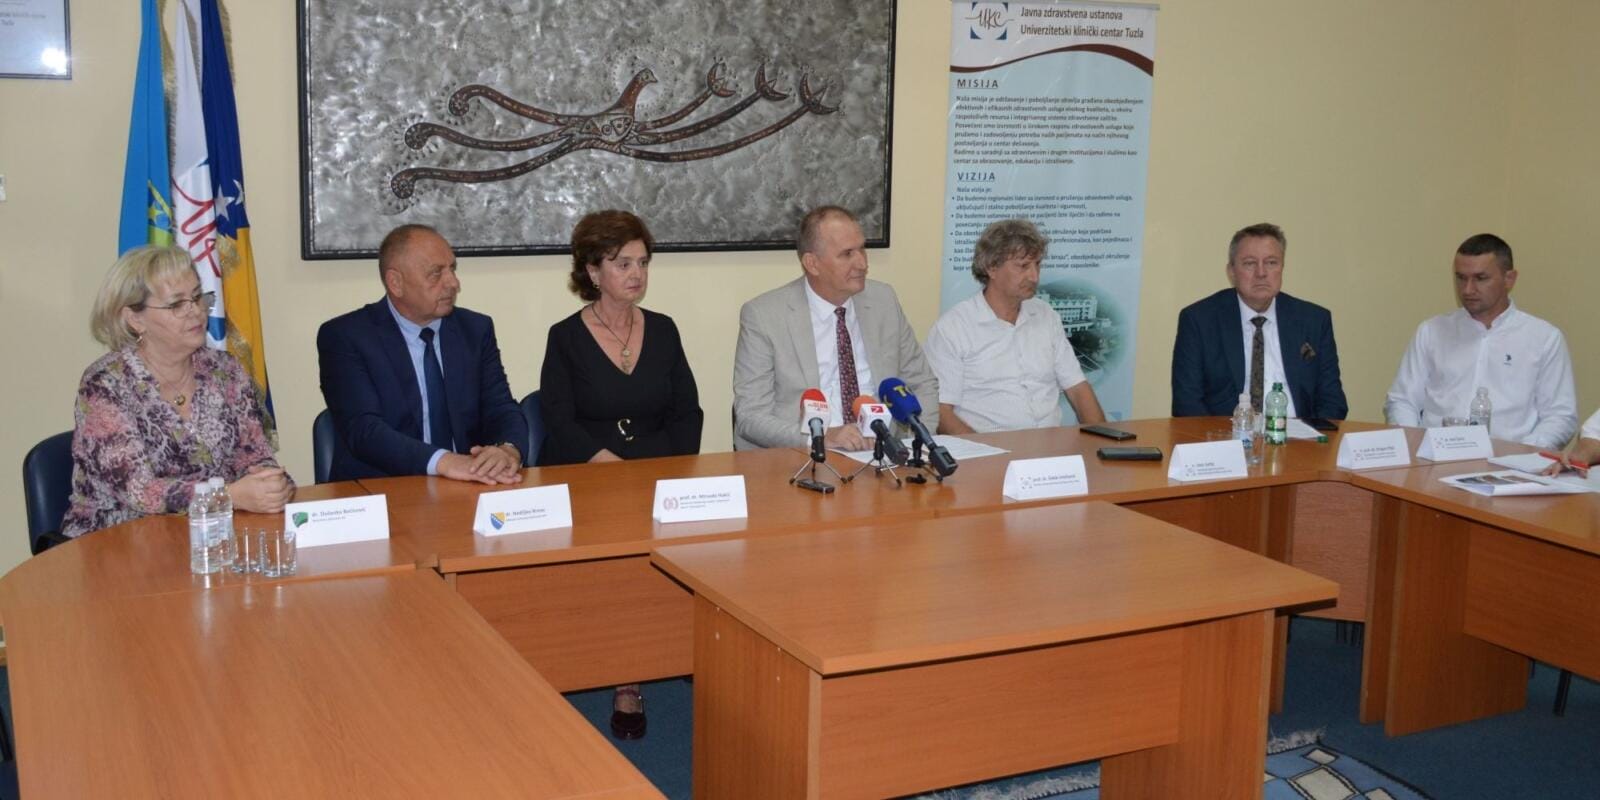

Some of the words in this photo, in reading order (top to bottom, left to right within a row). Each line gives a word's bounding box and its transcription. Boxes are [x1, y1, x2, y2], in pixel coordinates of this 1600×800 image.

[1021, 7, 1042, 18] Javna
[1044, 8, 1088, 19] zdravstvena
[1090, 11, 1123, 20] ustanova
[1020, 25, 1072, 36] Univerzitetski
[1073, 26, 1098, 36] klinički
[1100, 29, 1124, 38] centar
[1125, 27, 1144, 38] Tuzla
[957, 79, 998, 88] MISIJA
[957, 172, 995, 181] VIZIJA
